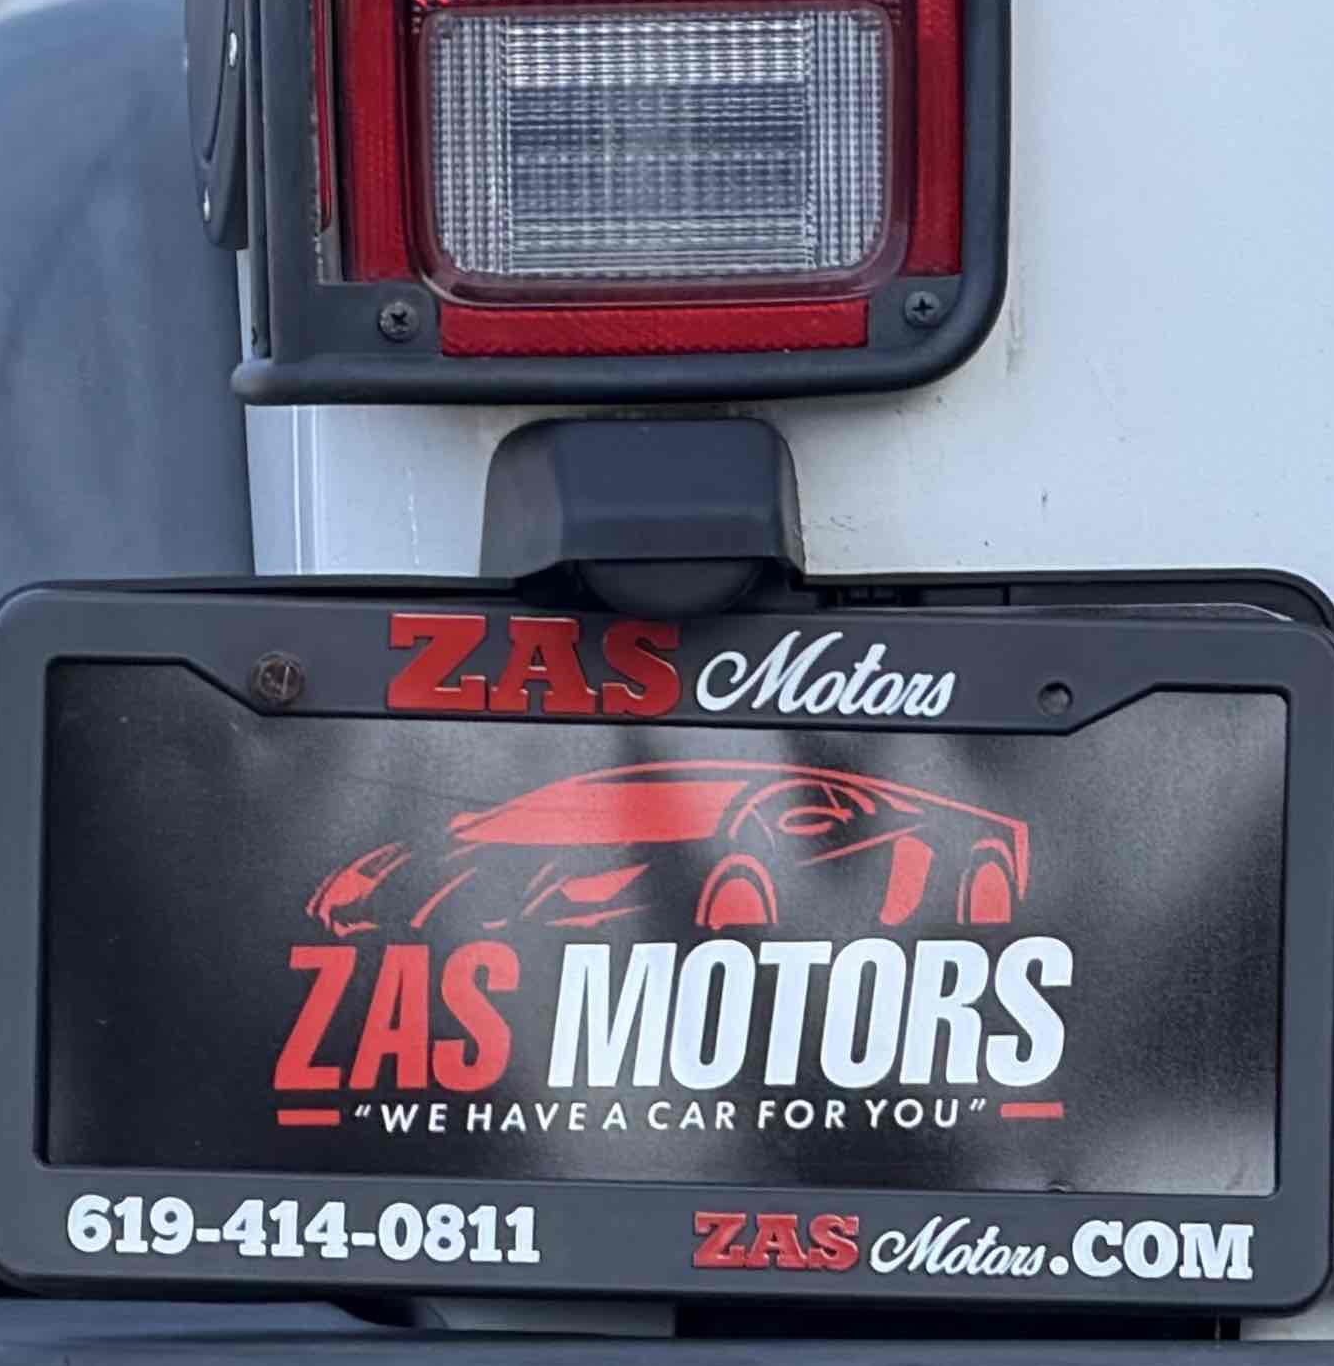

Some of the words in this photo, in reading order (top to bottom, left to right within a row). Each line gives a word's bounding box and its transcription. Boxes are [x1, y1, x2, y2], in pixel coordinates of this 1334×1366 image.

[387, 612, 683, 717] ZAS
[695, 630, 957, 718] Motors
[273, 939, 521, 1092] ZAS
[547, 935, 1074, 1091] MOTORS
[466, 1102, 588, 1132] HAVE
[601, 1102, 628, 1131] A
[647, 1099, 736, 1130] CAR
[757, 1099, 846, 1130] FOR
[66, 1193, 541, 1264] 619-414-0811
[692, 1210, 860, 1271] ZAS
